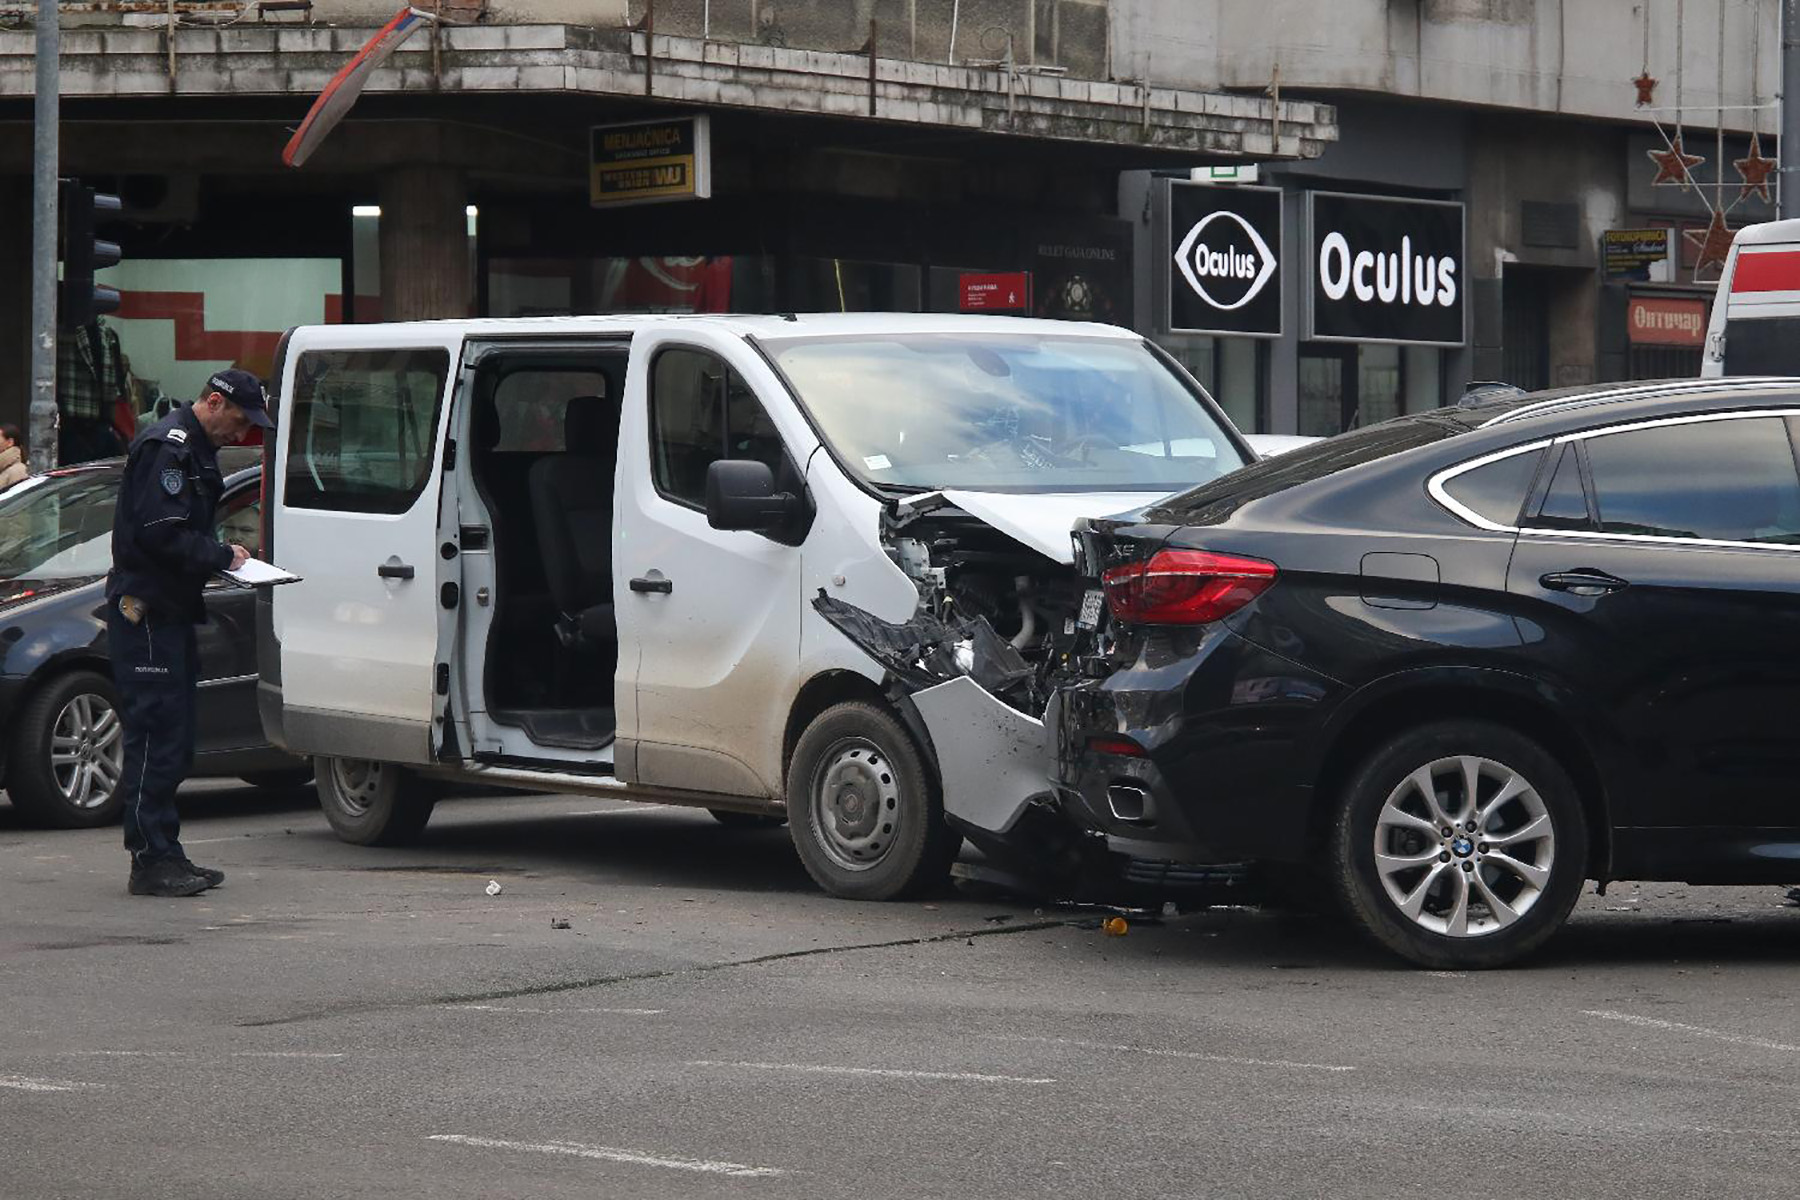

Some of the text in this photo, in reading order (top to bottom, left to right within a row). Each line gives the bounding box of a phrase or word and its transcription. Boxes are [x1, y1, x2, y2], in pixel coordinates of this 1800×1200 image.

[1195, 243, 1255, 278] Oculus
[1320, 232, 1456, 307] Oculus
[1634, 306, 1701, 337] Оптичар
